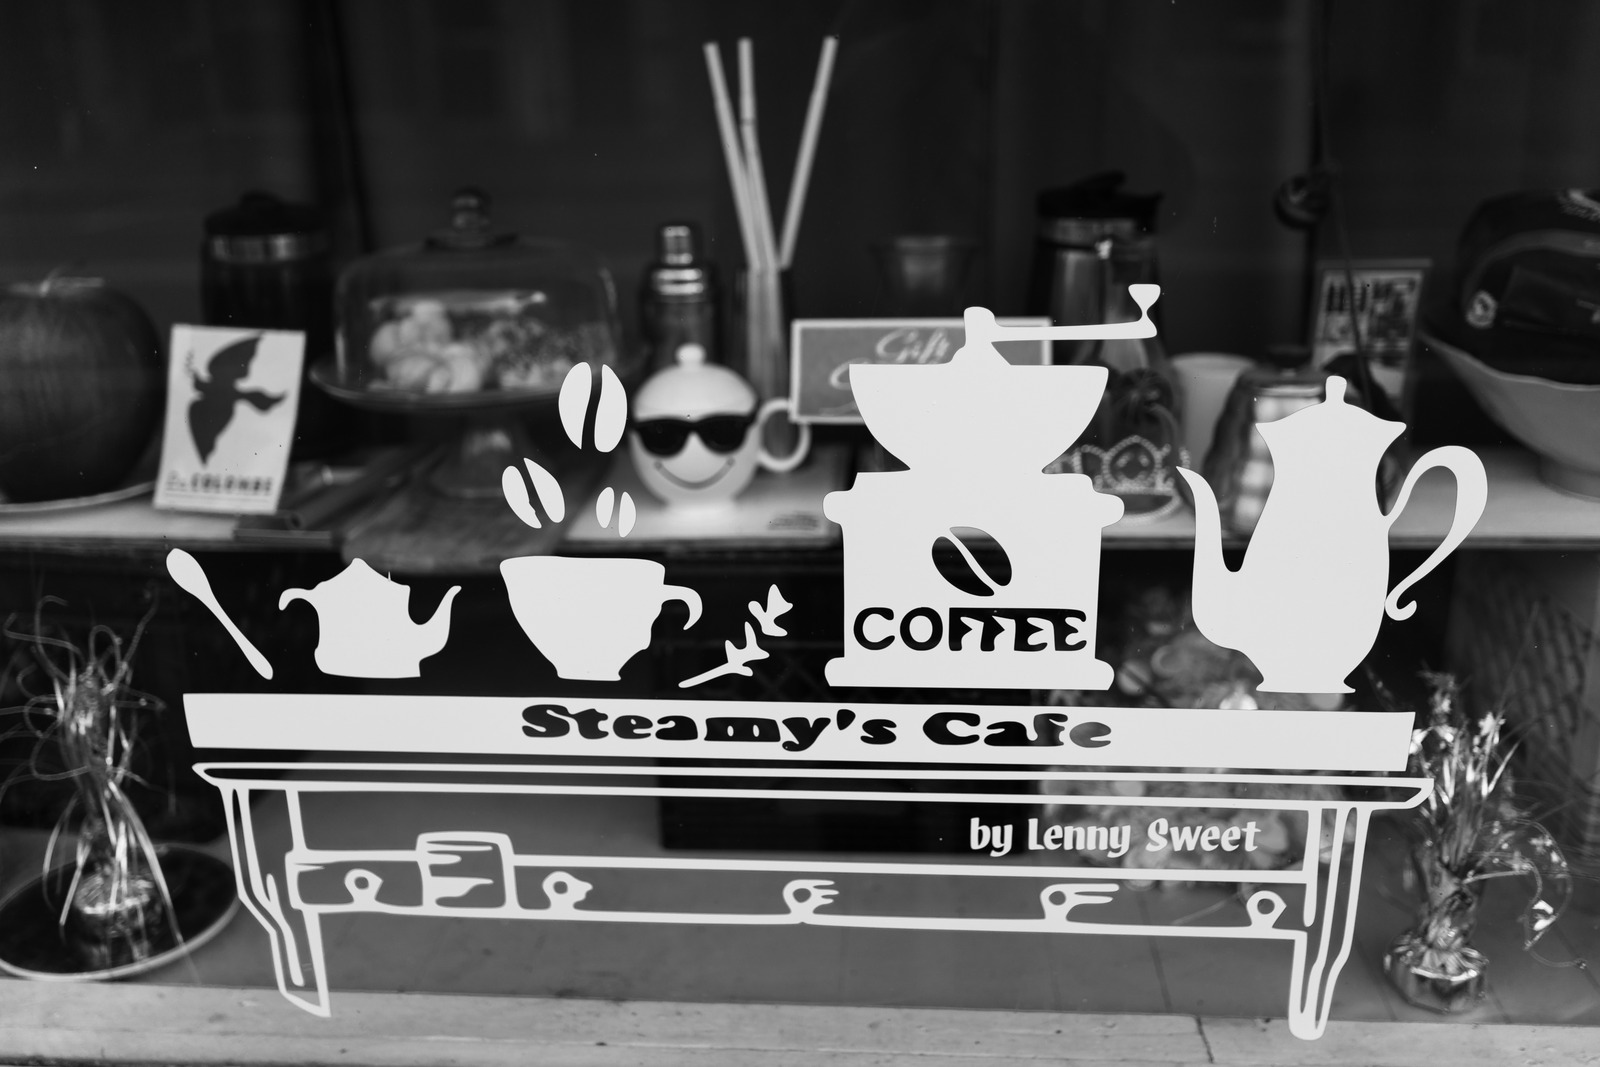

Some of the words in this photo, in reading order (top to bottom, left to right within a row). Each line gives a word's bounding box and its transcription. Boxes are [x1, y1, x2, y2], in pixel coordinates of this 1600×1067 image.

[853, 606, 1087, 651] COFFEE
[521, 704, 897, 752] Steamy's
[922, 711, 1112, 748] Cafe
[970, 817, 1013, 857] by
[1028, 818, 1131, 858] Lenny
[1145, 818, 1262, 852] Sweet
